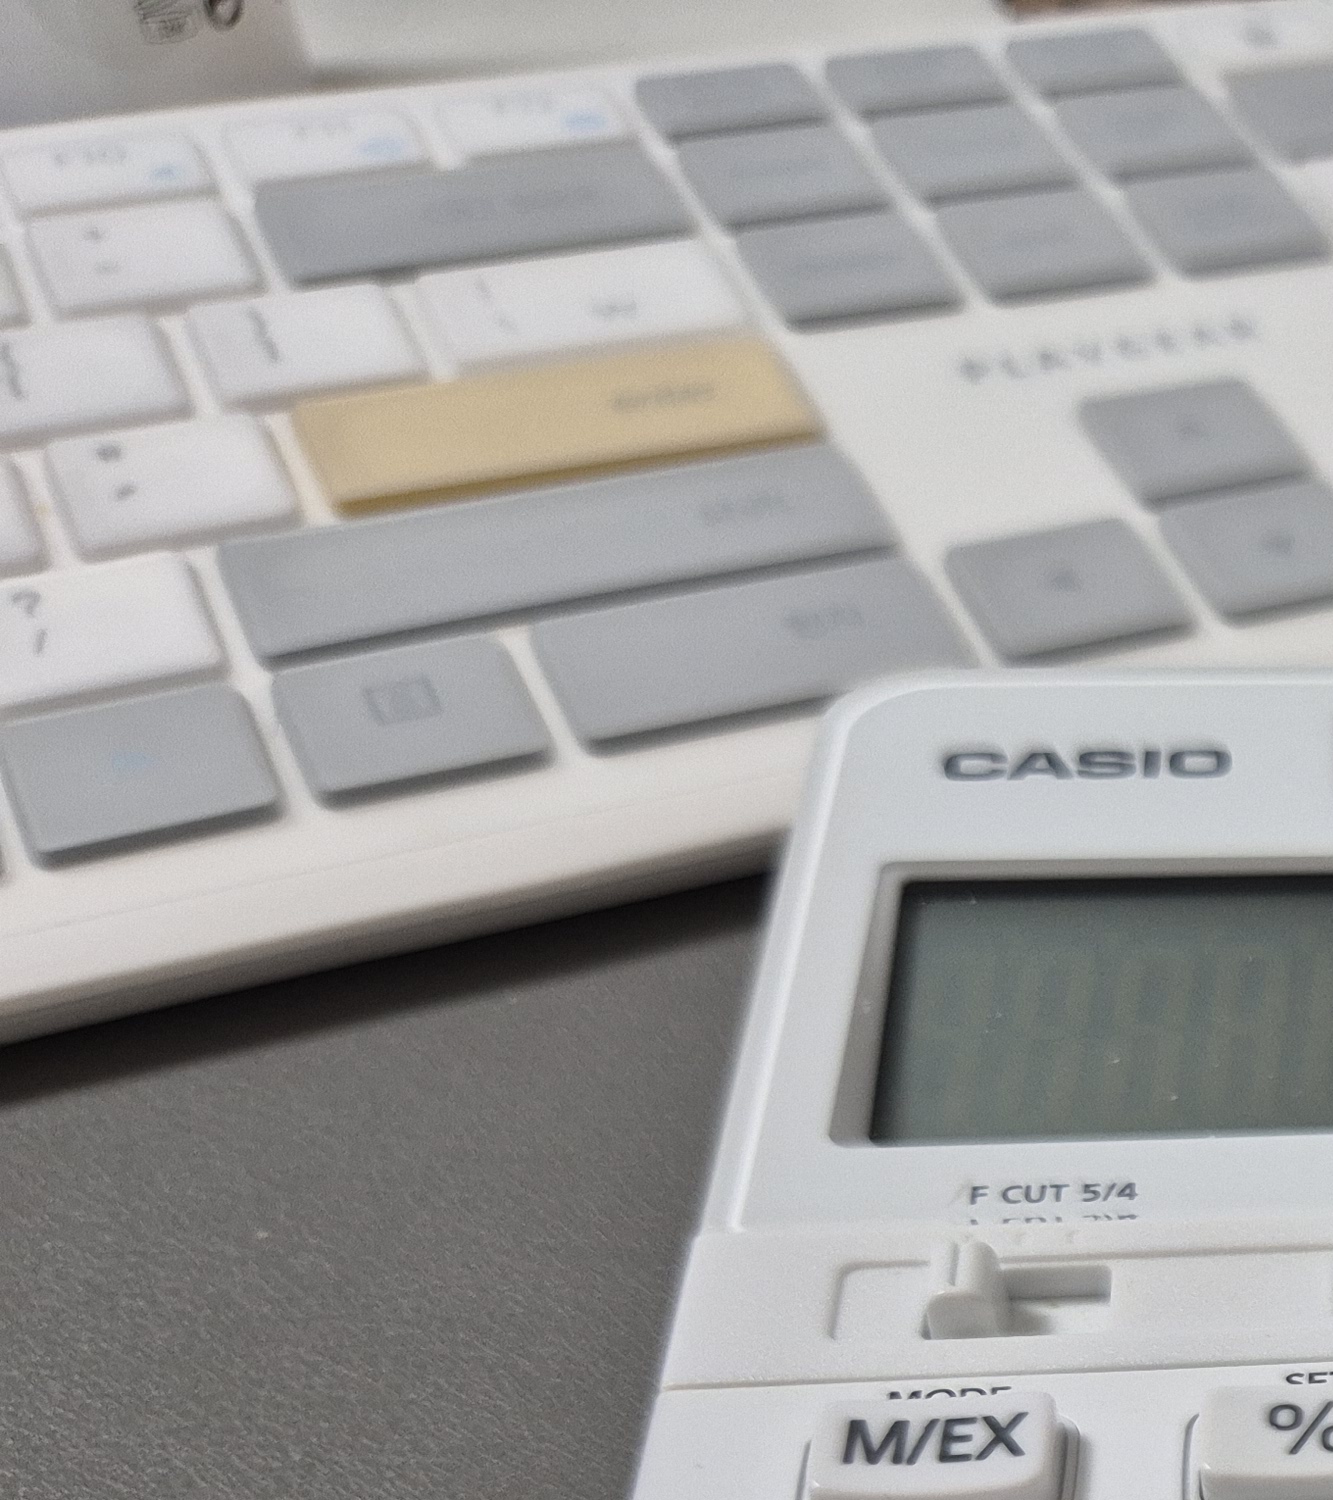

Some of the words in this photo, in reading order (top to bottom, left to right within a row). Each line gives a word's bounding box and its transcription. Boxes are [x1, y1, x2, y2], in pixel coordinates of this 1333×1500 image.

[940, 747, 1231, 781] CASIO
[969, 1185, 989, 1205] F
[999, 1183, 1070, 1205] CUT
[1081, 1181, 1138, 1203] 5/4
[840, 1411, 1028, 1466] M/EX
